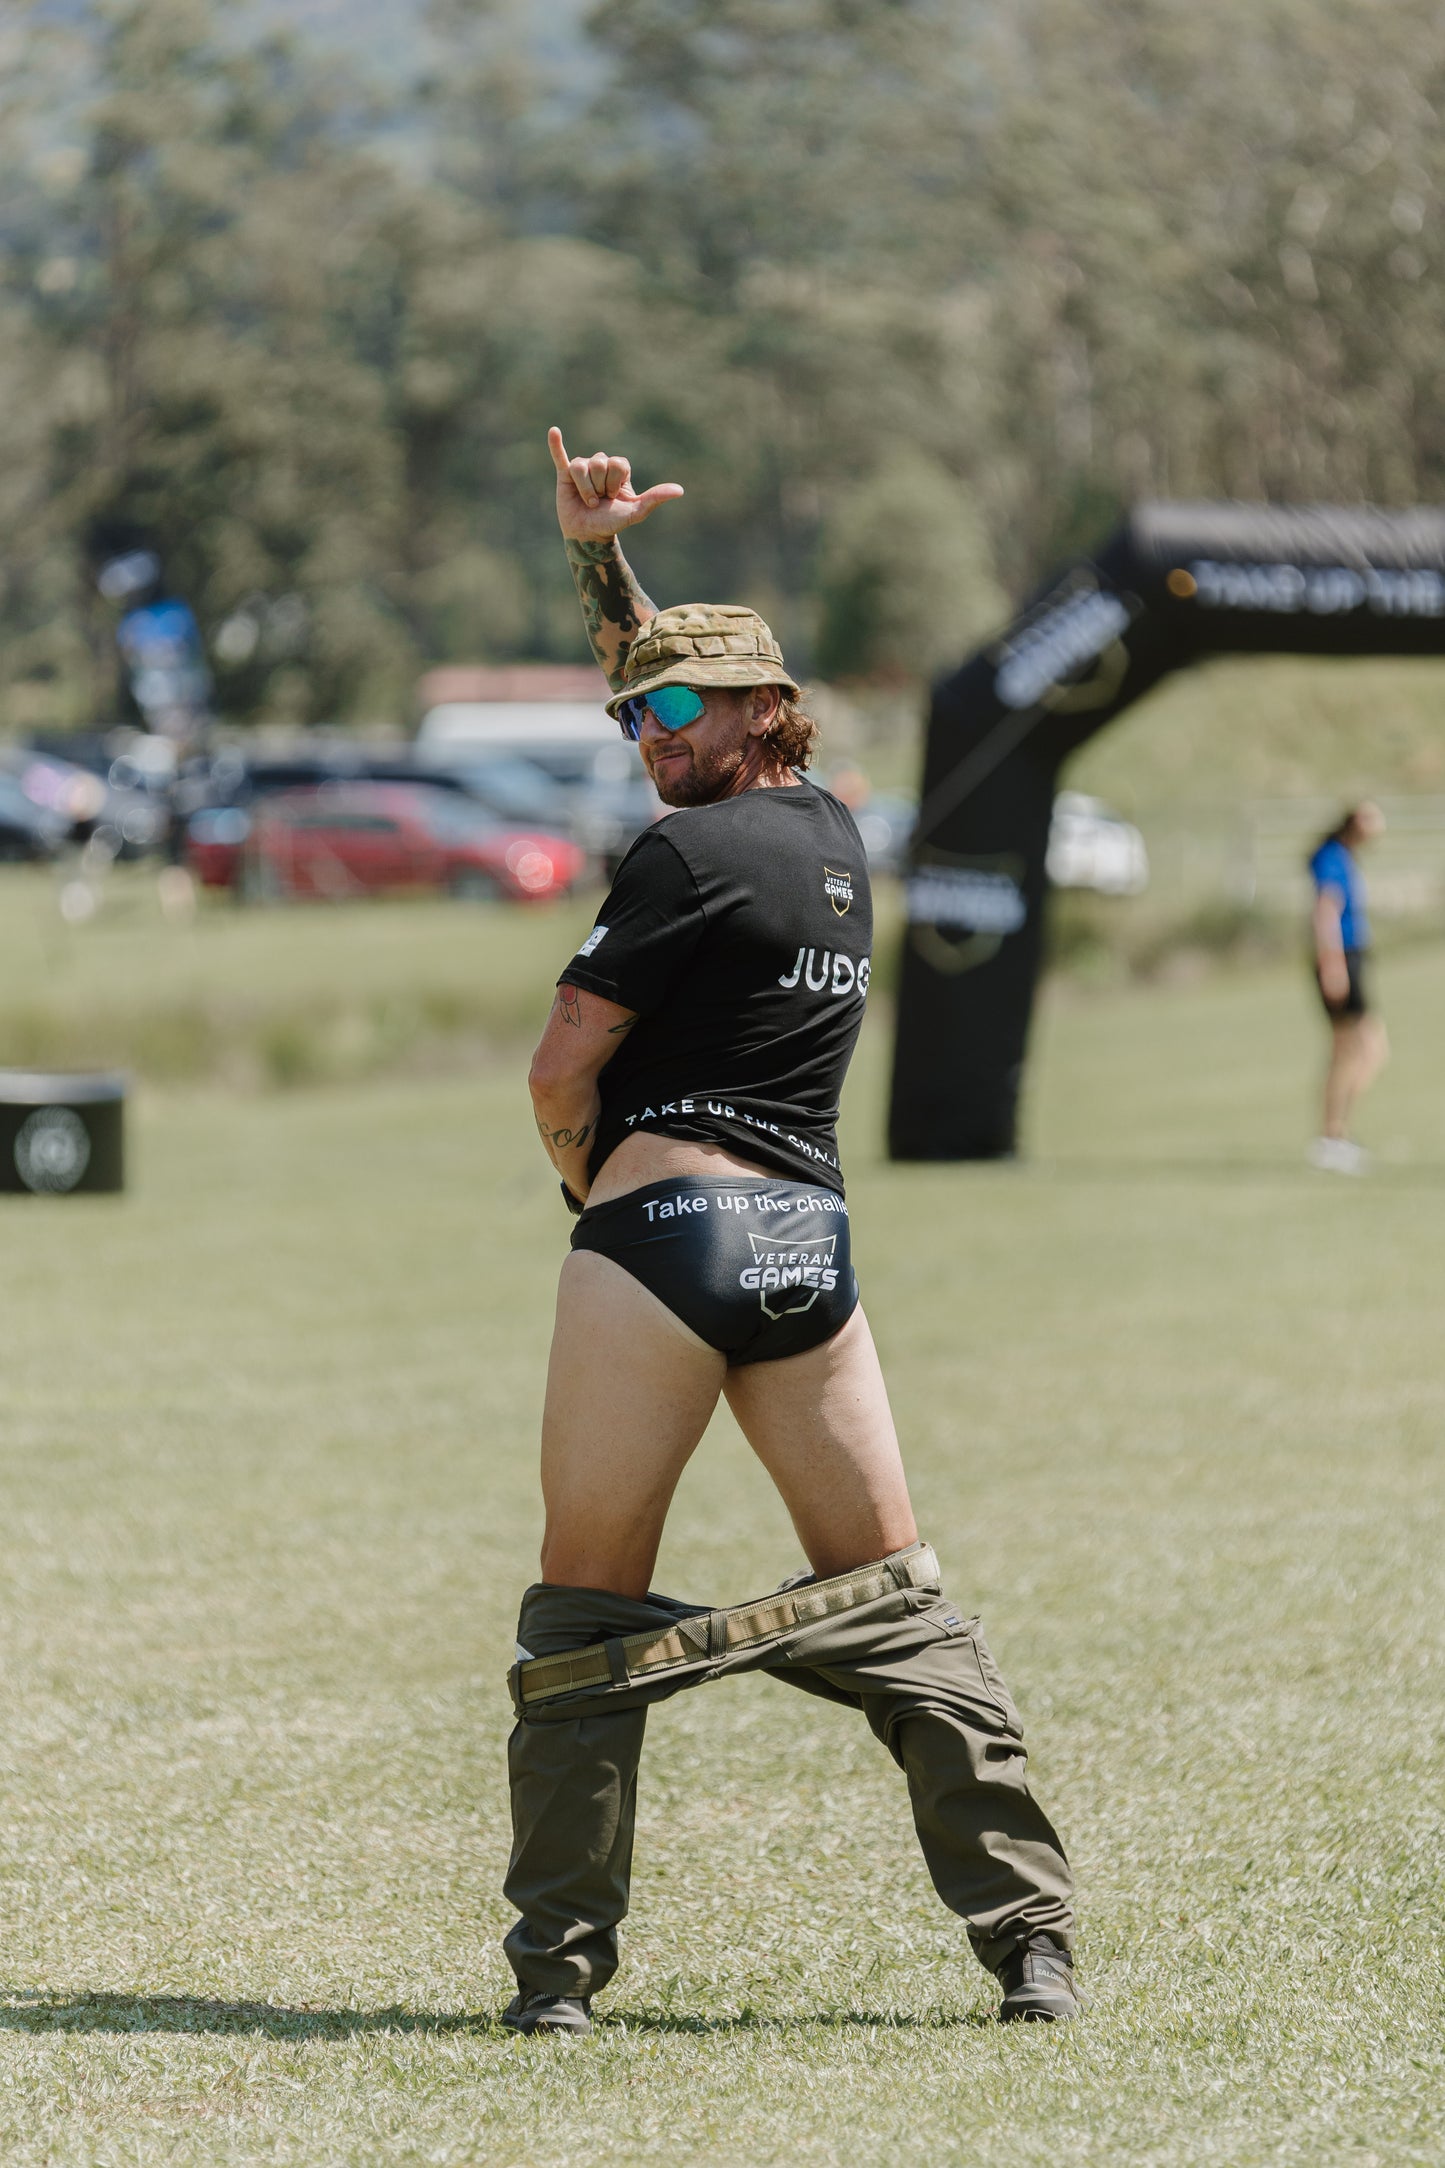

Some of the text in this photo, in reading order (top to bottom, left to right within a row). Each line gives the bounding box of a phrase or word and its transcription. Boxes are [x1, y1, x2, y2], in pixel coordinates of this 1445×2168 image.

[824, 882, 854, 900] GAMES
[826, 876, 850, 889] VETERAN
[624, 1098, 696, 1126] TAKE
[707, 1100, 736, 1119] UP
[787, 1134, 841, 1171] CHALL
[641, 1195, 708, 1222] Take
[716, 1194, 750, 1214] up
[754, 1193, 791, 1212] the
[753, 1253, 834, 1266] VETERAN
[739, 1266, 840, 1291] GAMES
